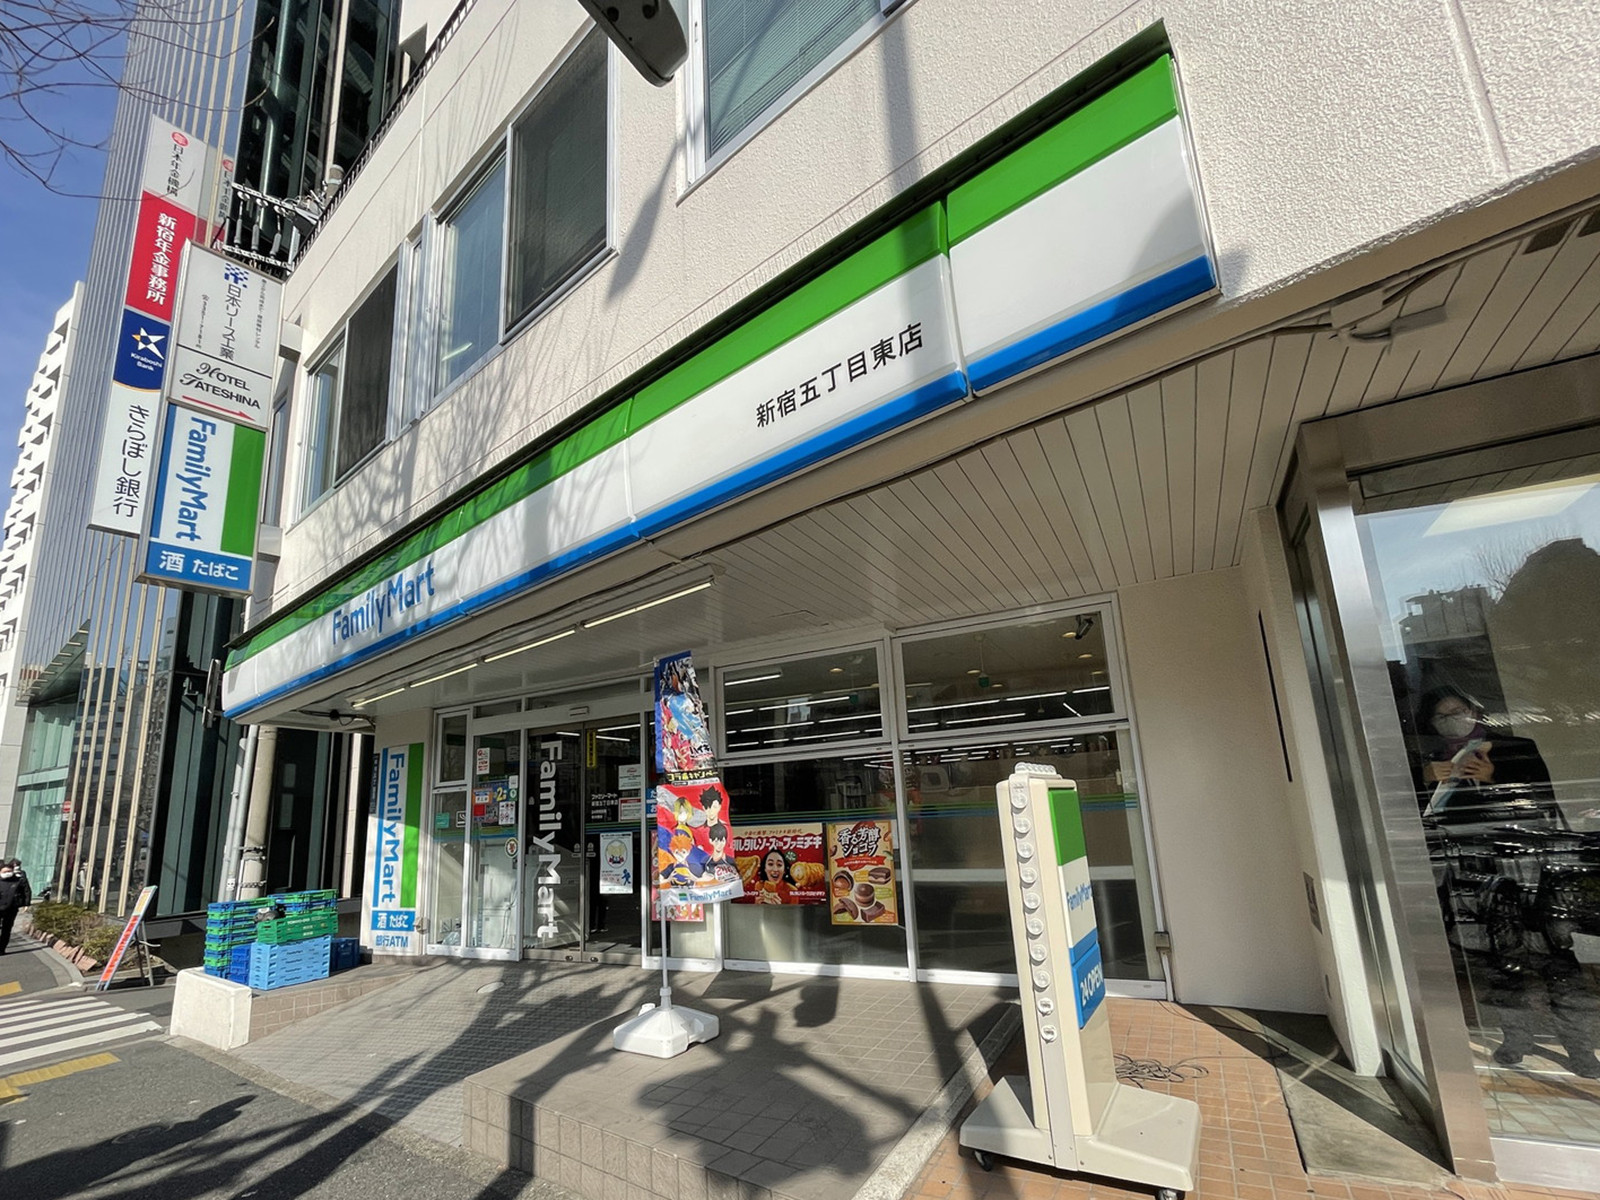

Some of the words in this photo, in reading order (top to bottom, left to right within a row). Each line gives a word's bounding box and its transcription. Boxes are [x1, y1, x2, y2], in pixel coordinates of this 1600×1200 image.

[146, 212, 177, 305] 新宿年金事務所
[220, 283, 242, 361] 日本リース工業
[130, 352, 163, 368] Kiraboshi
[136, 361, 154, 371] Bank
[196, 362, 251, 391] HOTEL
[756, 322, 923, 428] 新宿五丁目東店
[179, 372, 261, 410] TATESHINA
[112, 404, 150, 518] きらぼし銀行
[175, 416, 217, 542] FamilyMart
[158, 550, 186, 574] 酒
[192, 558, 239, 581] たばこ
[332, 560, 435, 645] FamilyMart
[381, 753, 405, 904] FamilyMart
[532, 740, 563, 939] FamilyMart
[838, 827, 881, 845] 香る芳醇
[843, 842, 878, 857] ショコラ
[688, 889, 733, 901] FamilyMart
[1066, 882, 1092, 910] FamilyMar
[377, 912, 388, 929] 酒
[389, 914, 409, 928] たばこ
